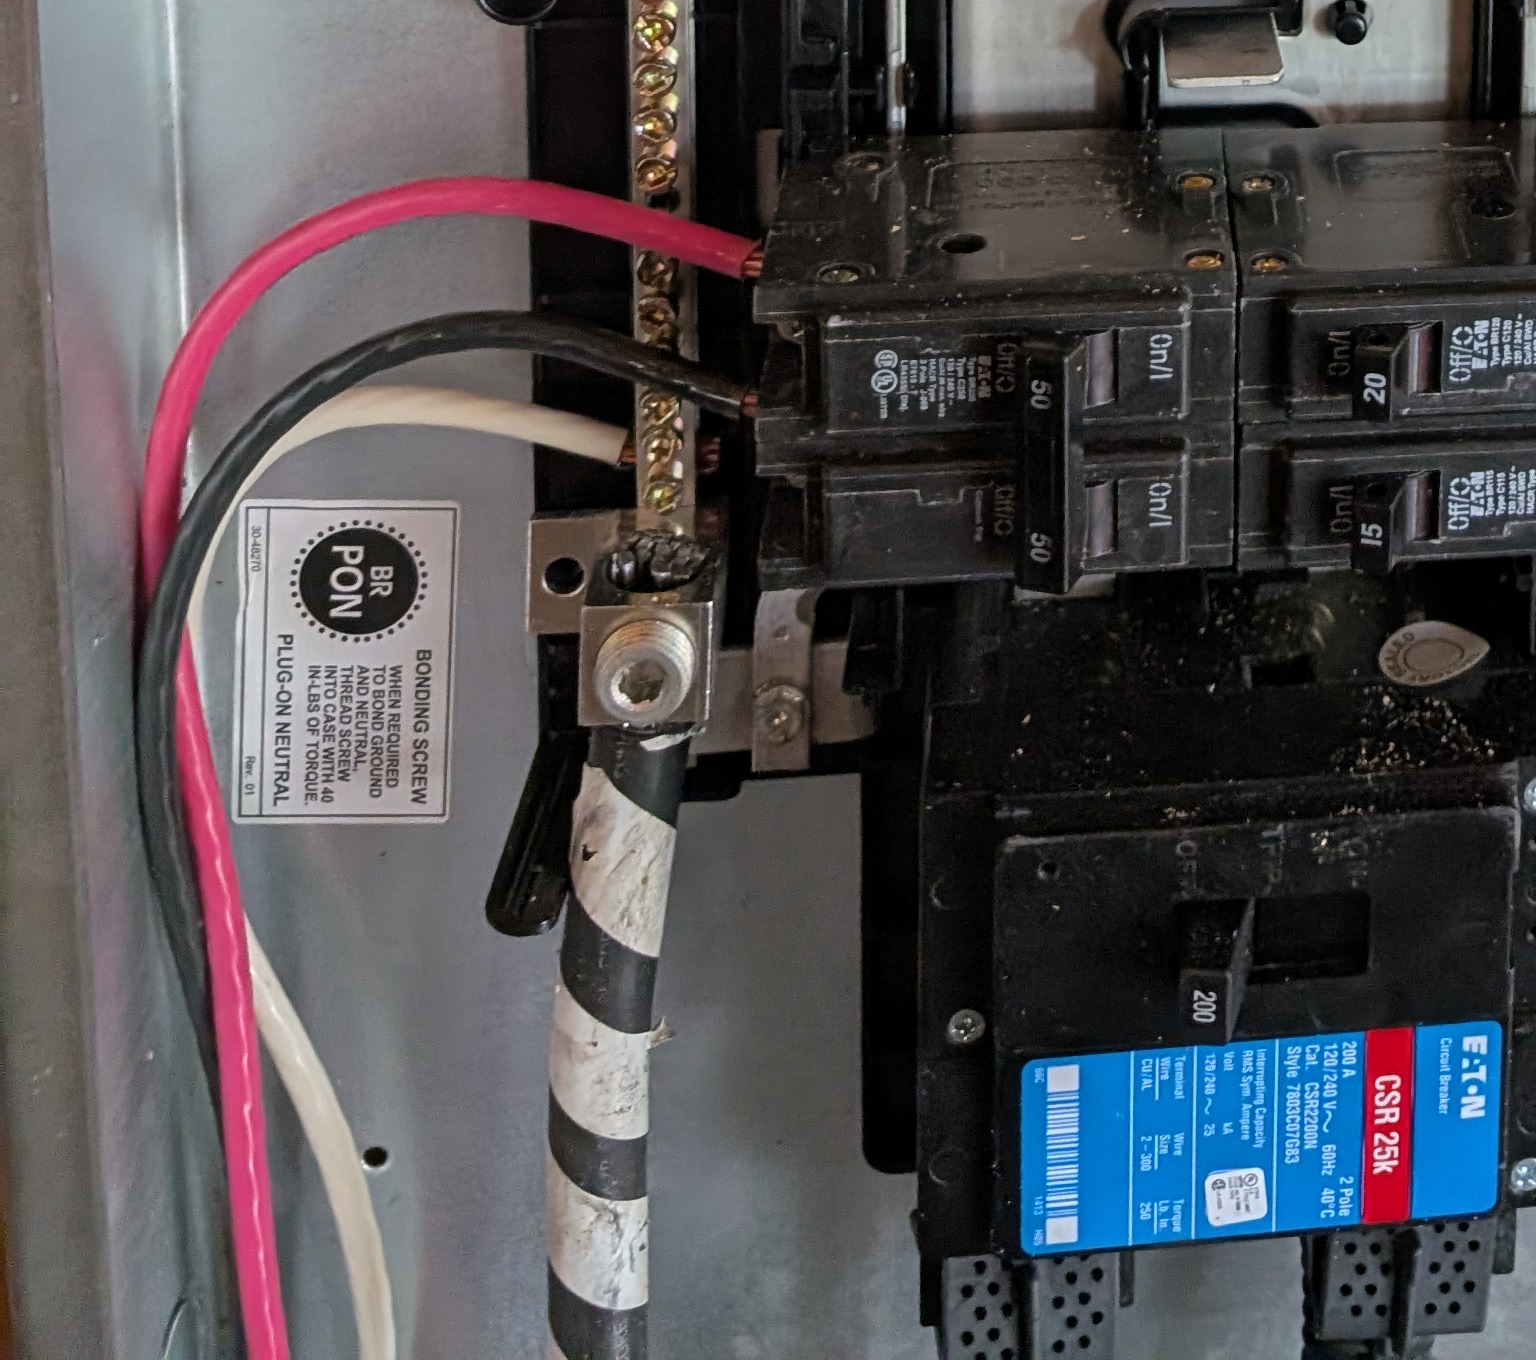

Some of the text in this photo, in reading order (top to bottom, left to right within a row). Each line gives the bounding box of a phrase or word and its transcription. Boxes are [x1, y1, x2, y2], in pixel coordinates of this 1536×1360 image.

[1471, 320, 1489, 369] EATON
[1490, 346, 1501, 366] Type
[1501, 344, 1513, 366] Type
[1030, 380, 1052, 410] 50
[1363, 372, 1387, 404] 20
[1470, 472, 1485, 516] EATON
[1485, 497, 1494, 516] Type
[1496, 495, 1505, 516] Type
[1030, 532, 1052, 563] 50
[1360, 523, 1383, 547] 15
[328, 545, 364, 618] PON
[369, 565, 394, 597] BR
[244, 525, 262, 796] 30-48270 Rev. 01
[273, 634, 293, 807] PLUG-ON NEUTRAL
[303, 665, 322, 806] IN-LBS OF TORQUE.
[321, 665, 338, 803] INTO CASE WITH 40
[337, 666, 354, 783] THREAD SCREW
[352, 665, 369, 772] AND NEUTRAL,
[369, 667, 386, 798] TO BOND GROUND
[385, 665, 403, 788] WHEN REQUIRED
[410, 649, 432, 804] BONDING SCREW
[1191, 989, 1217, 1025] 200
[1141, 1058, 1153, 1091] CU/AL
[1160, 1057, 1171, 1080] Wire
[1242, 1050, 1252, 1073] RMS
[1438, 1038, 1453, 1115] Circuit Breaker
[1460, 1035, 1487, 1119] EATON
[1223, 1051, 1234, 1135] Volt kA
[1239, 1103, 1252, 1140] Ampere
[1252, 1048, 1267, 1148] Interrupting Capacity
[1283, 1046, 1300, 1164] Style 7803C07G83
[1304, 1044, 1319, 1149] Cat. CSR2200N
[1159, 1134, 1169, 1154] Size
[1171, 1055, 1185, 1232] Terminal Wire Torque
[1203, 1124, 1214, 1137] 25
[1320, 1043, 1338, 1218] 120/240 60Hz 40°C
[1338, 1041, 1357, 1217] 200 A 2 Pole
[1372, 1074, 1401, 1175] CSR 25k
[1140, 1153, 1151, 1171] 300
[1140, 1202, 1151, 1220] 250
